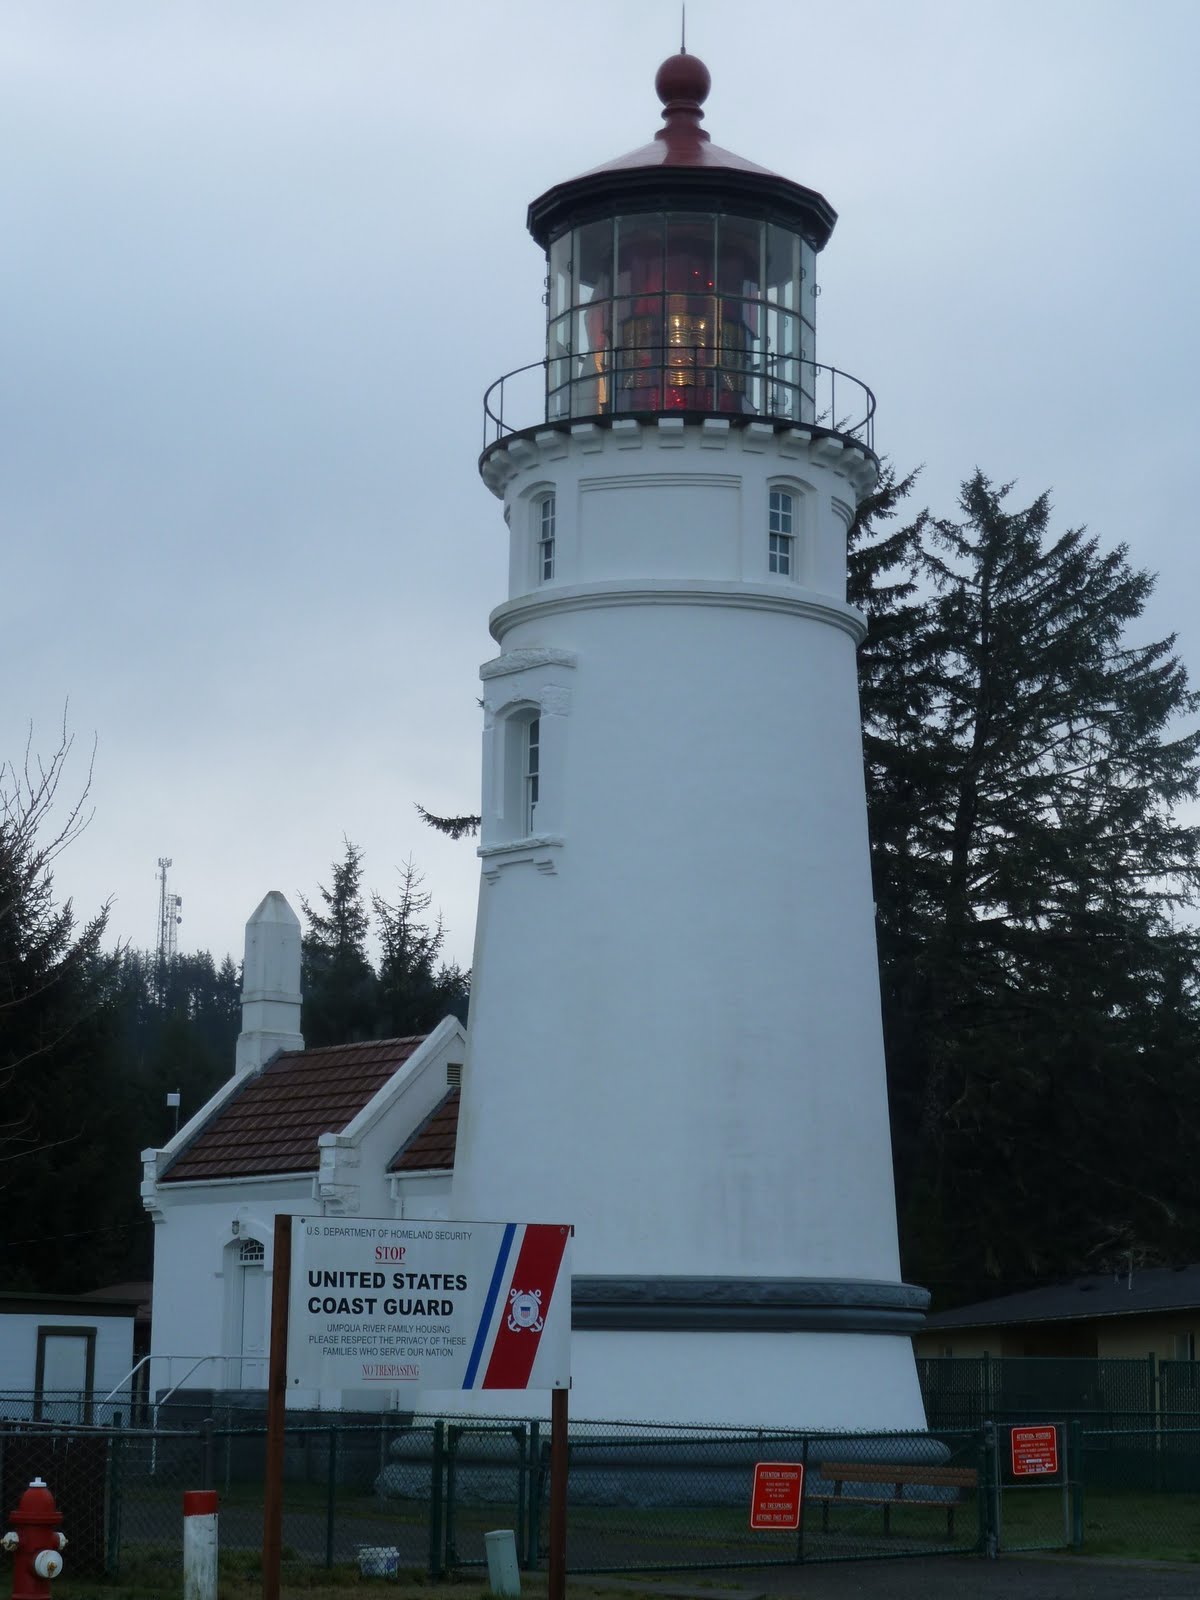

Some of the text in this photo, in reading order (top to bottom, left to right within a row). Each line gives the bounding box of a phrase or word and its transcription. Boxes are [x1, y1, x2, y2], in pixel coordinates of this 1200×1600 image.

[307, 1227, 472, 1241] U.S. DEPARTMENT OF HOMELAND SECURITY
[375, 1246, 406, 1260] STOP
[308, 1270, 468, 1291] UNITED STATES
[308, 1296, 454, 1316] COAST GUARD
[326, 1323, 451, 1334] UMPQUA RIVER FAMILY HOUSING
[308, 1335, 467, 1346] PLEASE RESPECT THE PRIVACY OF THESE
[322, 1347, 454, 1357] FAMILIES WHO SERVE OUR NATION
[362, 1364, 420, 1377] NO TRESPASSING
[760, 1471, 780, 1479] ATTENTION
